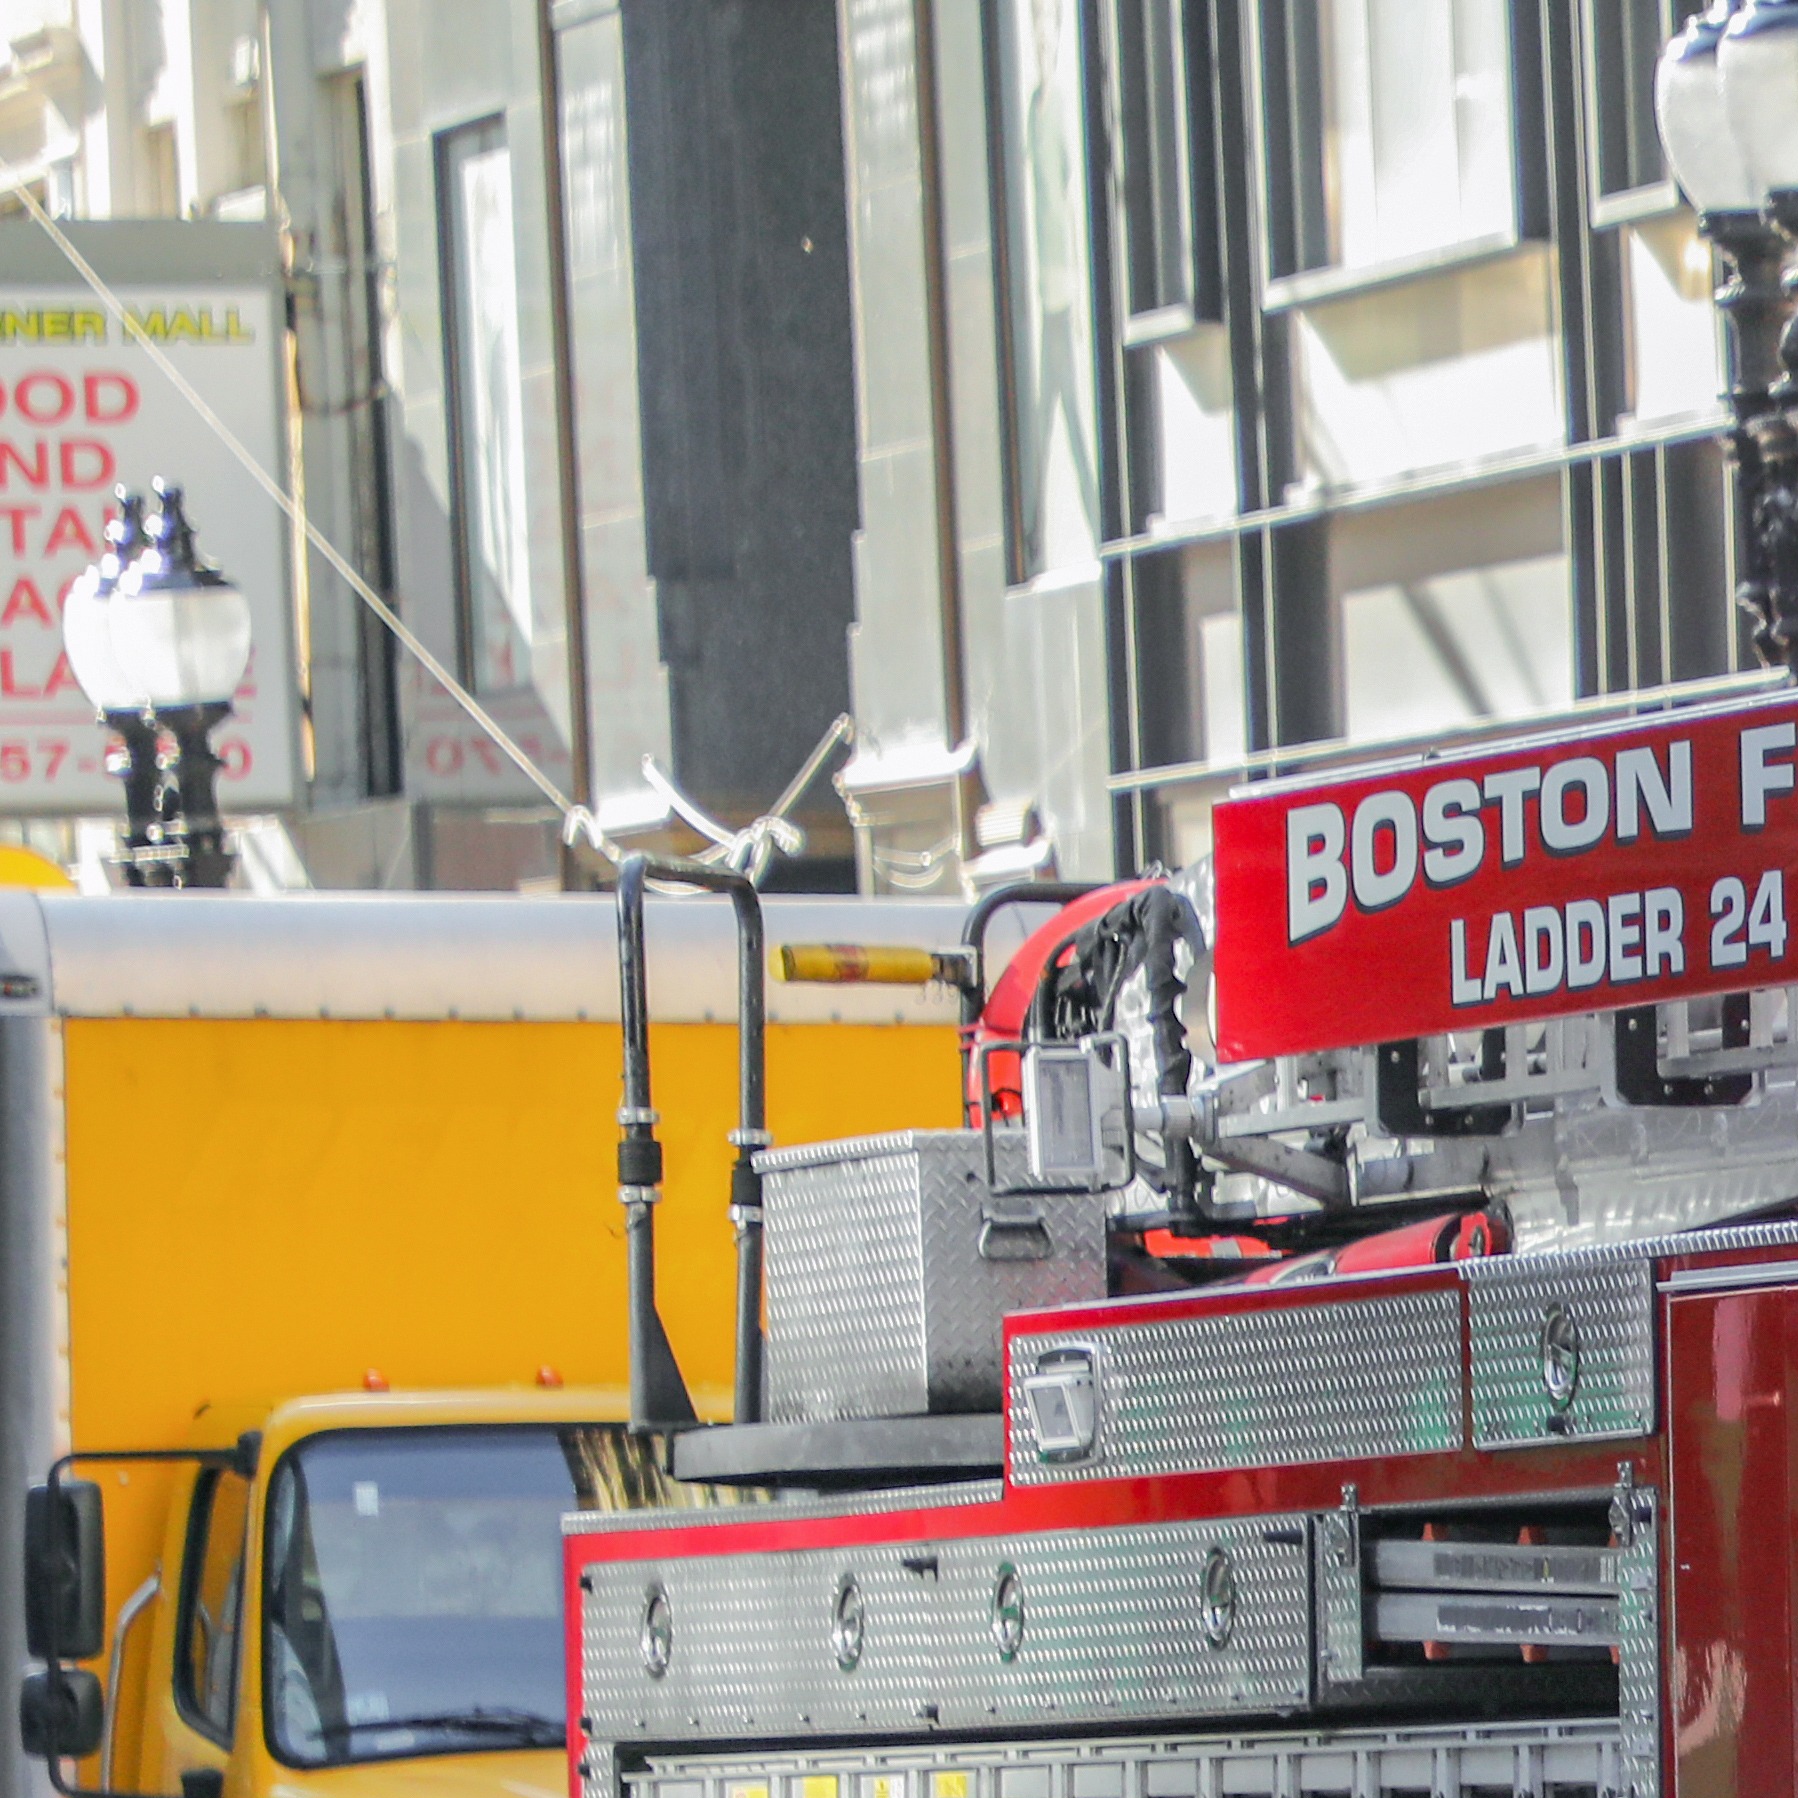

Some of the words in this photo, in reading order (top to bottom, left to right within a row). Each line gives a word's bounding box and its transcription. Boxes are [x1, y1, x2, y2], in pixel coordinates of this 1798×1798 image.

[122, 309, 254, 343] MALL
[1286, 741, 1694, 944] BOSTON
[1450, 884, 1686, 1006] LADDER
[1708, 869, 1788, 968] 24
